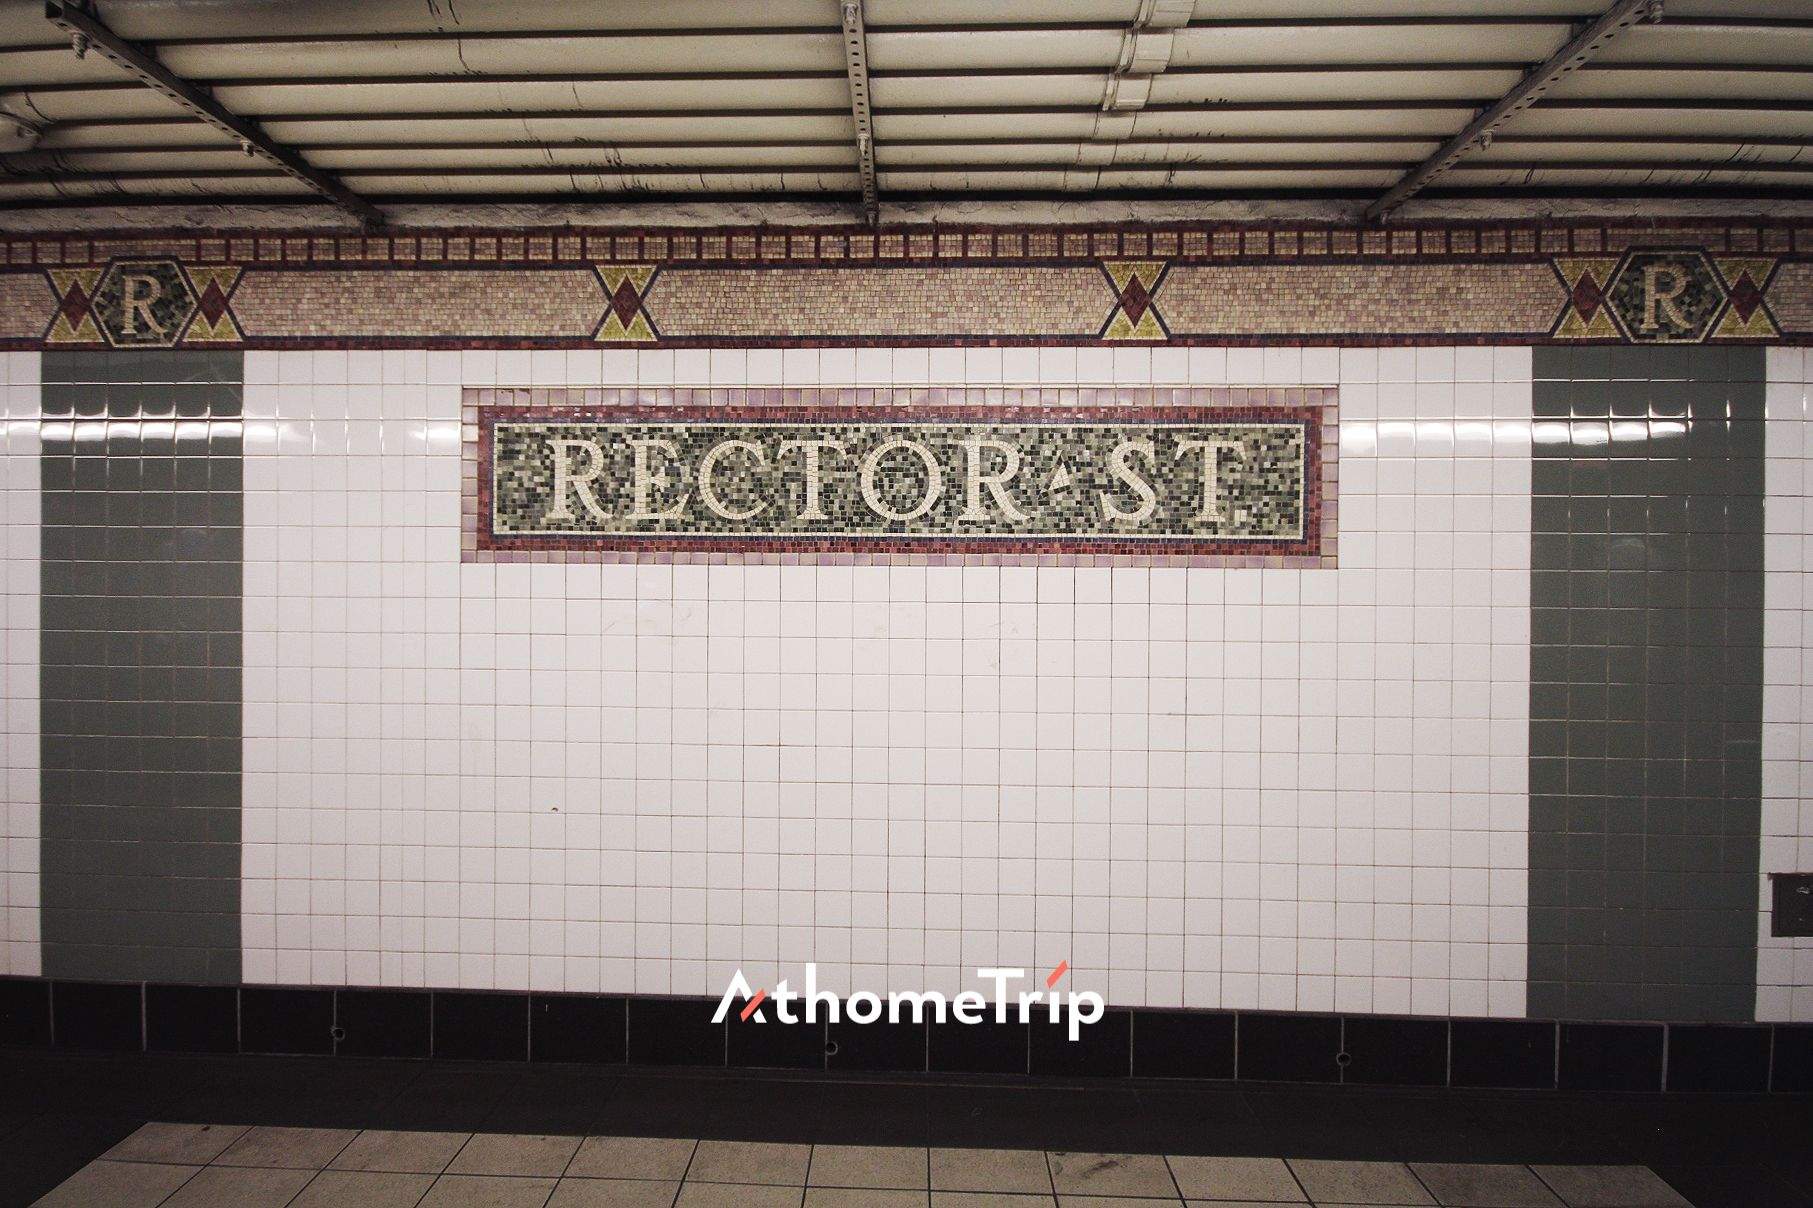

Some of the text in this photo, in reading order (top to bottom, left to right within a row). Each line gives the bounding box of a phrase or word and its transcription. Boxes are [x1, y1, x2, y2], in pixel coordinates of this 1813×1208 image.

[121, 275, 168, 334] R
[1641, 265, 1695, 329] R
[545, 435, 1249, 523] RECTOR ST
